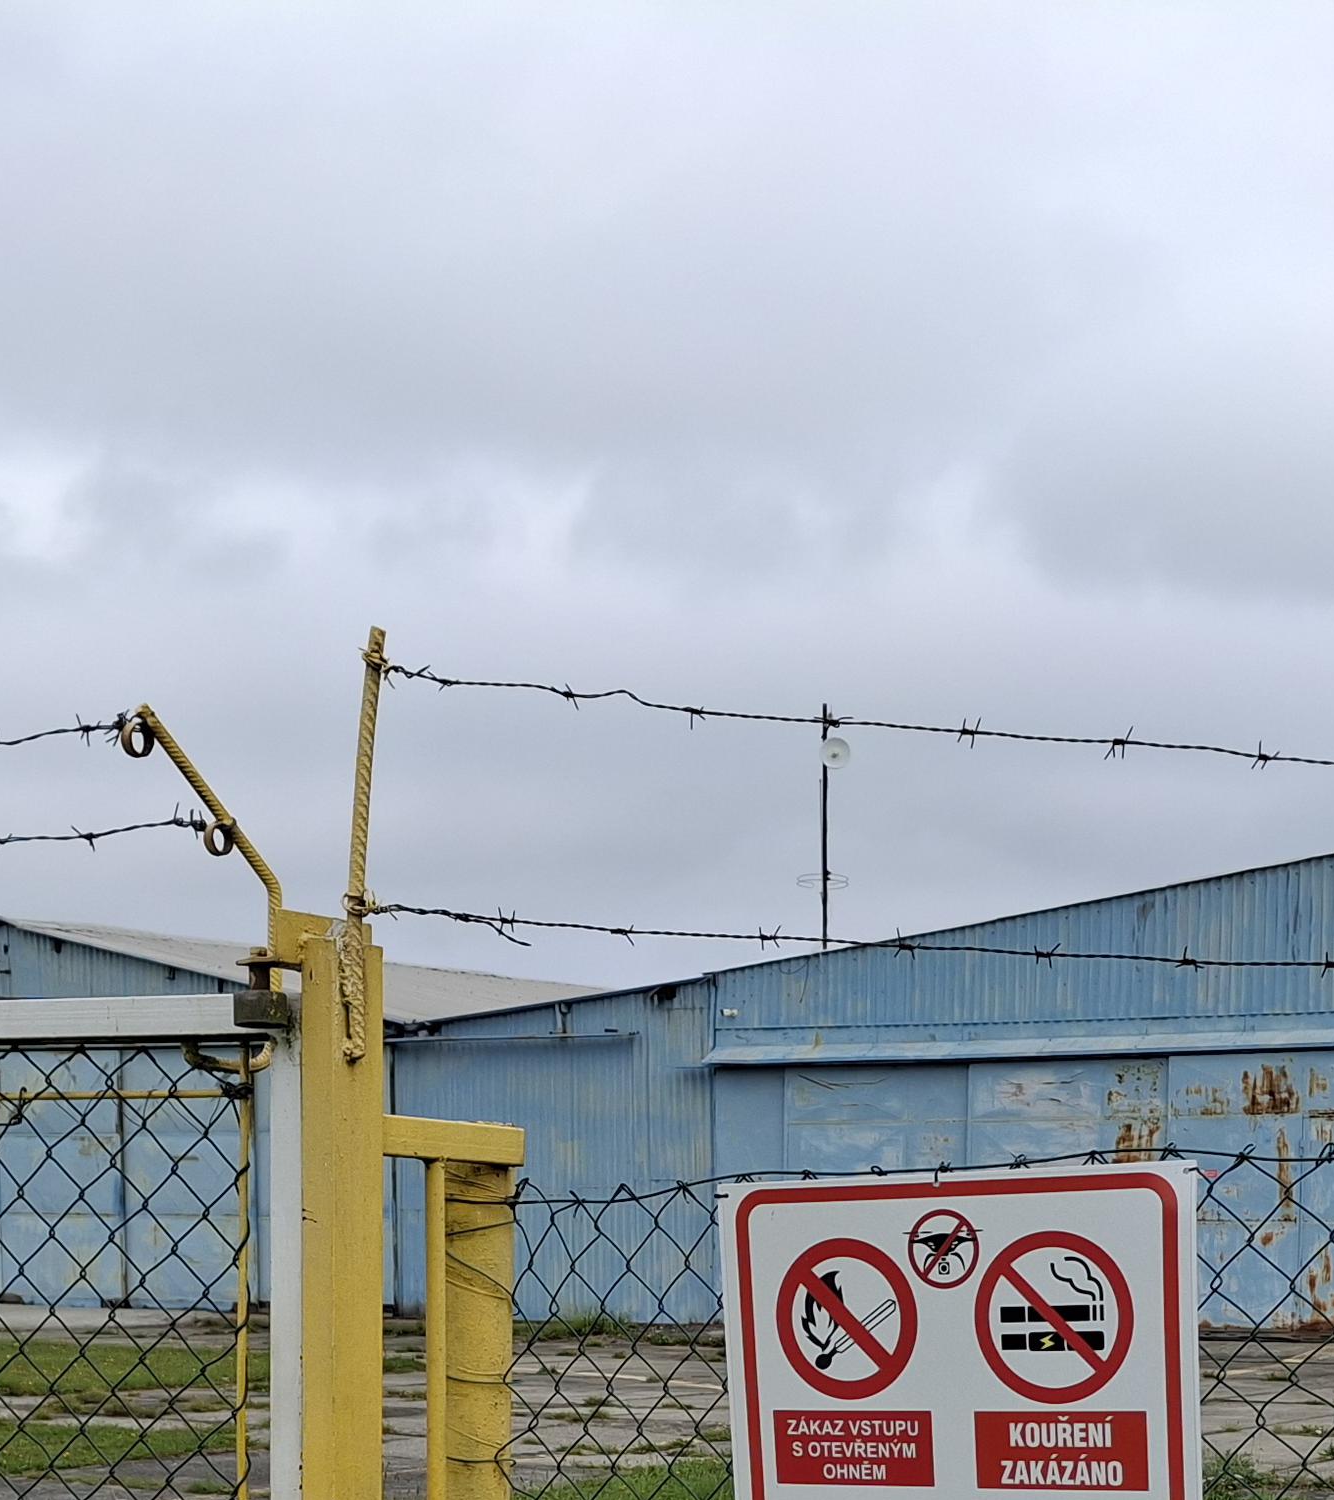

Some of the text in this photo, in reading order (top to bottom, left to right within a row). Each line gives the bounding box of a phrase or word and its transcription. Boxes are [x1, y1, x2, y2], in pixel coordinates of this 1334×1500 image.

[787, 1417, 919, 1437] ZÁKAZ VSTUPU
[1009, 1416, 1112, 1448] KOUŘENÍ
[792, 1438, 916, 1459] S OTEVŘENÝM
[824, 1460, 886, 1480] OHNĚM
[1000, 1455, 1123, 1486] ZAKÁZÁNO
